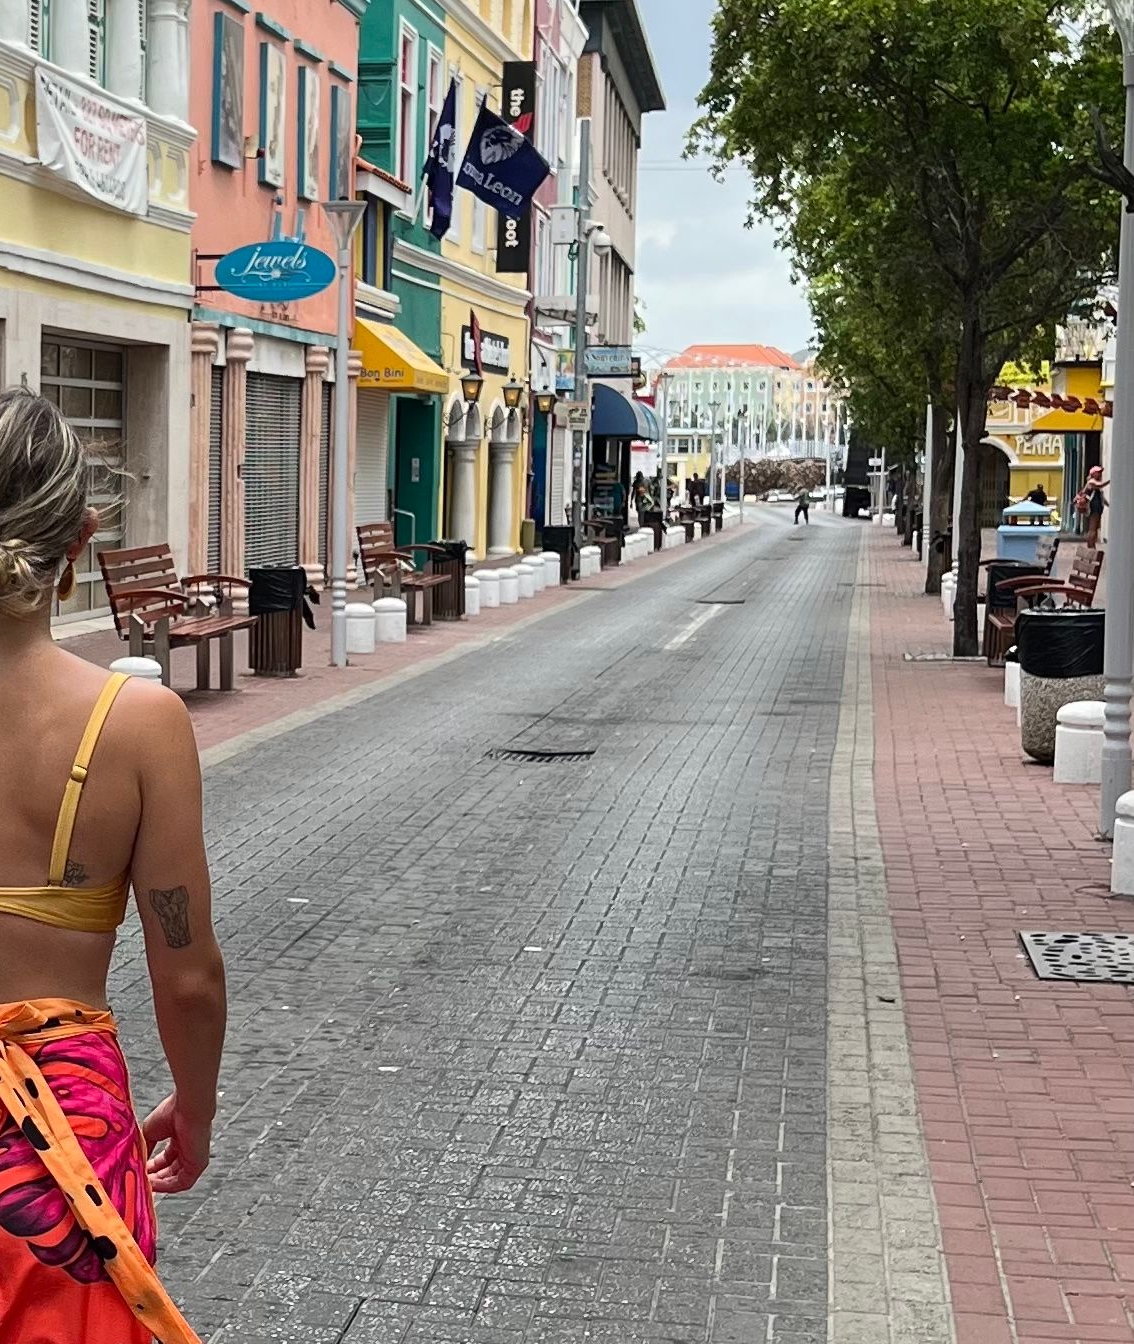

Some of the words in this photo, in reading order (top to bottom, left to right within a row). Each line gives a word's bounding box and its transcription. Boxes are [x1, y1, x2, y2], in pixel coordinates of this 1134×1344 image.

[510, 87, 525, 117] the
[483, 172, 524, 207] Leon
[505, 216, 520, 248] oot
[360, 367, 380, 378] Bon
[384, 367, 404, 378] Bini
[1015, 434, 1063, 456] PENHA
